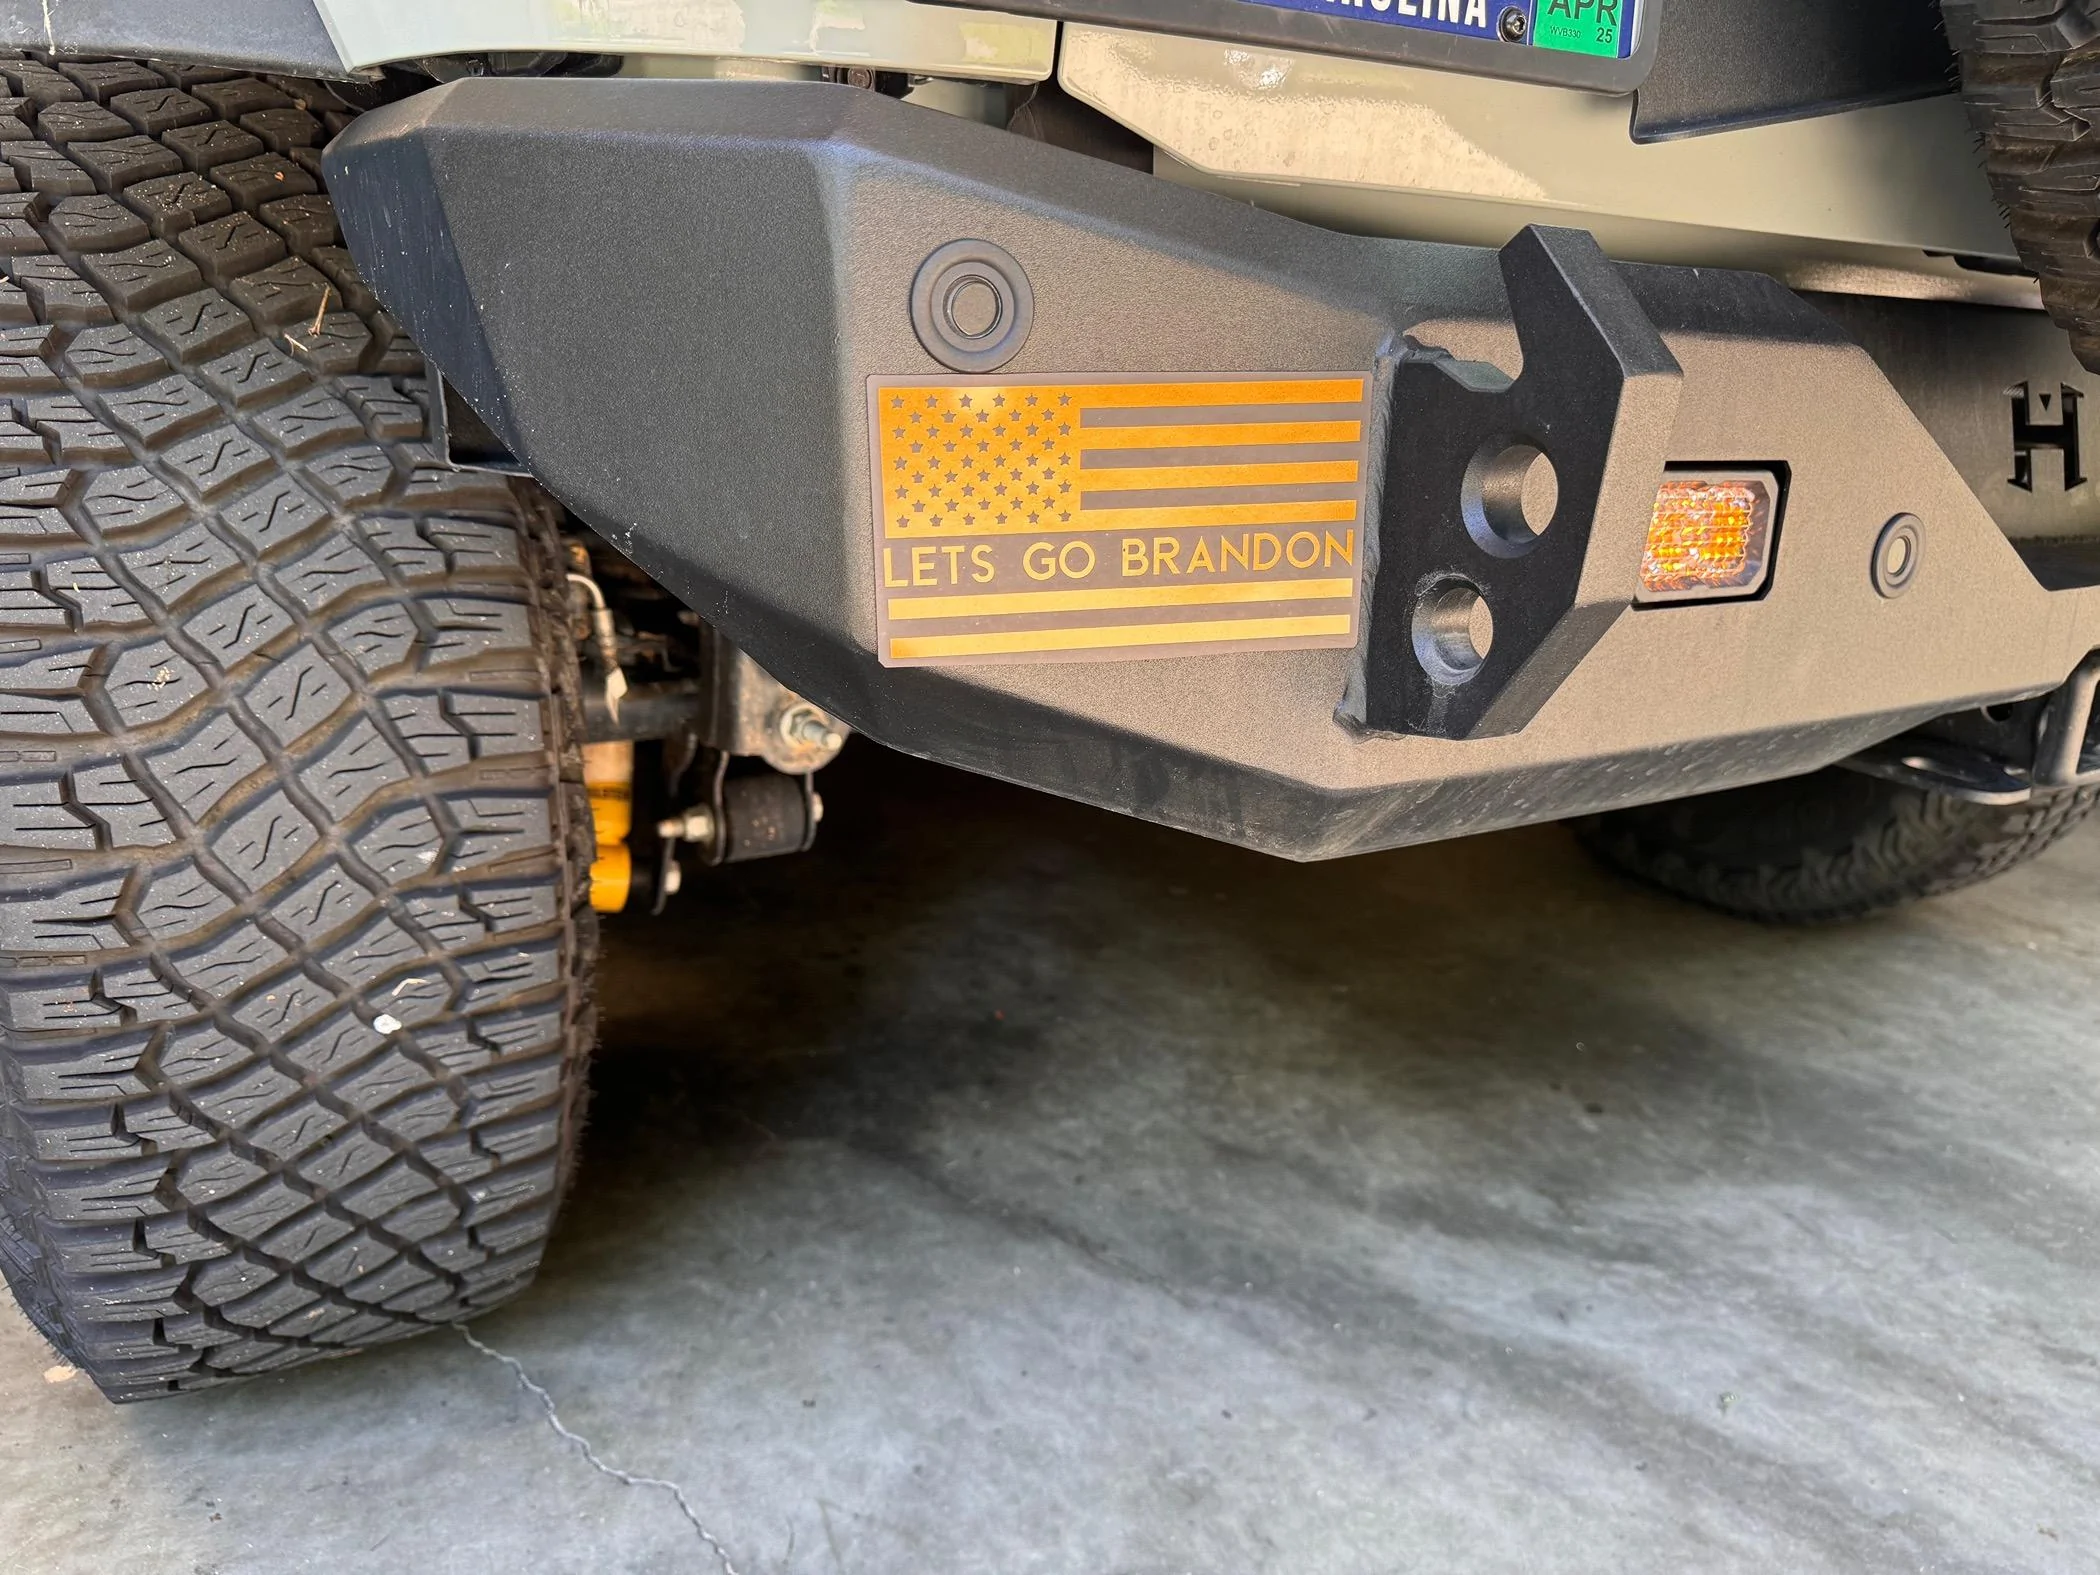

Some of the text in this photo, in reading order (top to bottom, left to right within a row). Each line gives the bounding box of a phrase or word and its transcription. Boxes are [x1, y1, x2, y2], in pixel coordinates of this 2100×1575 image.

[1547, 0, 1617, 26] APR
[1596, 28, 1613, 43] 25
[883, 529, 1354, 588] LETS GO BRANDON
